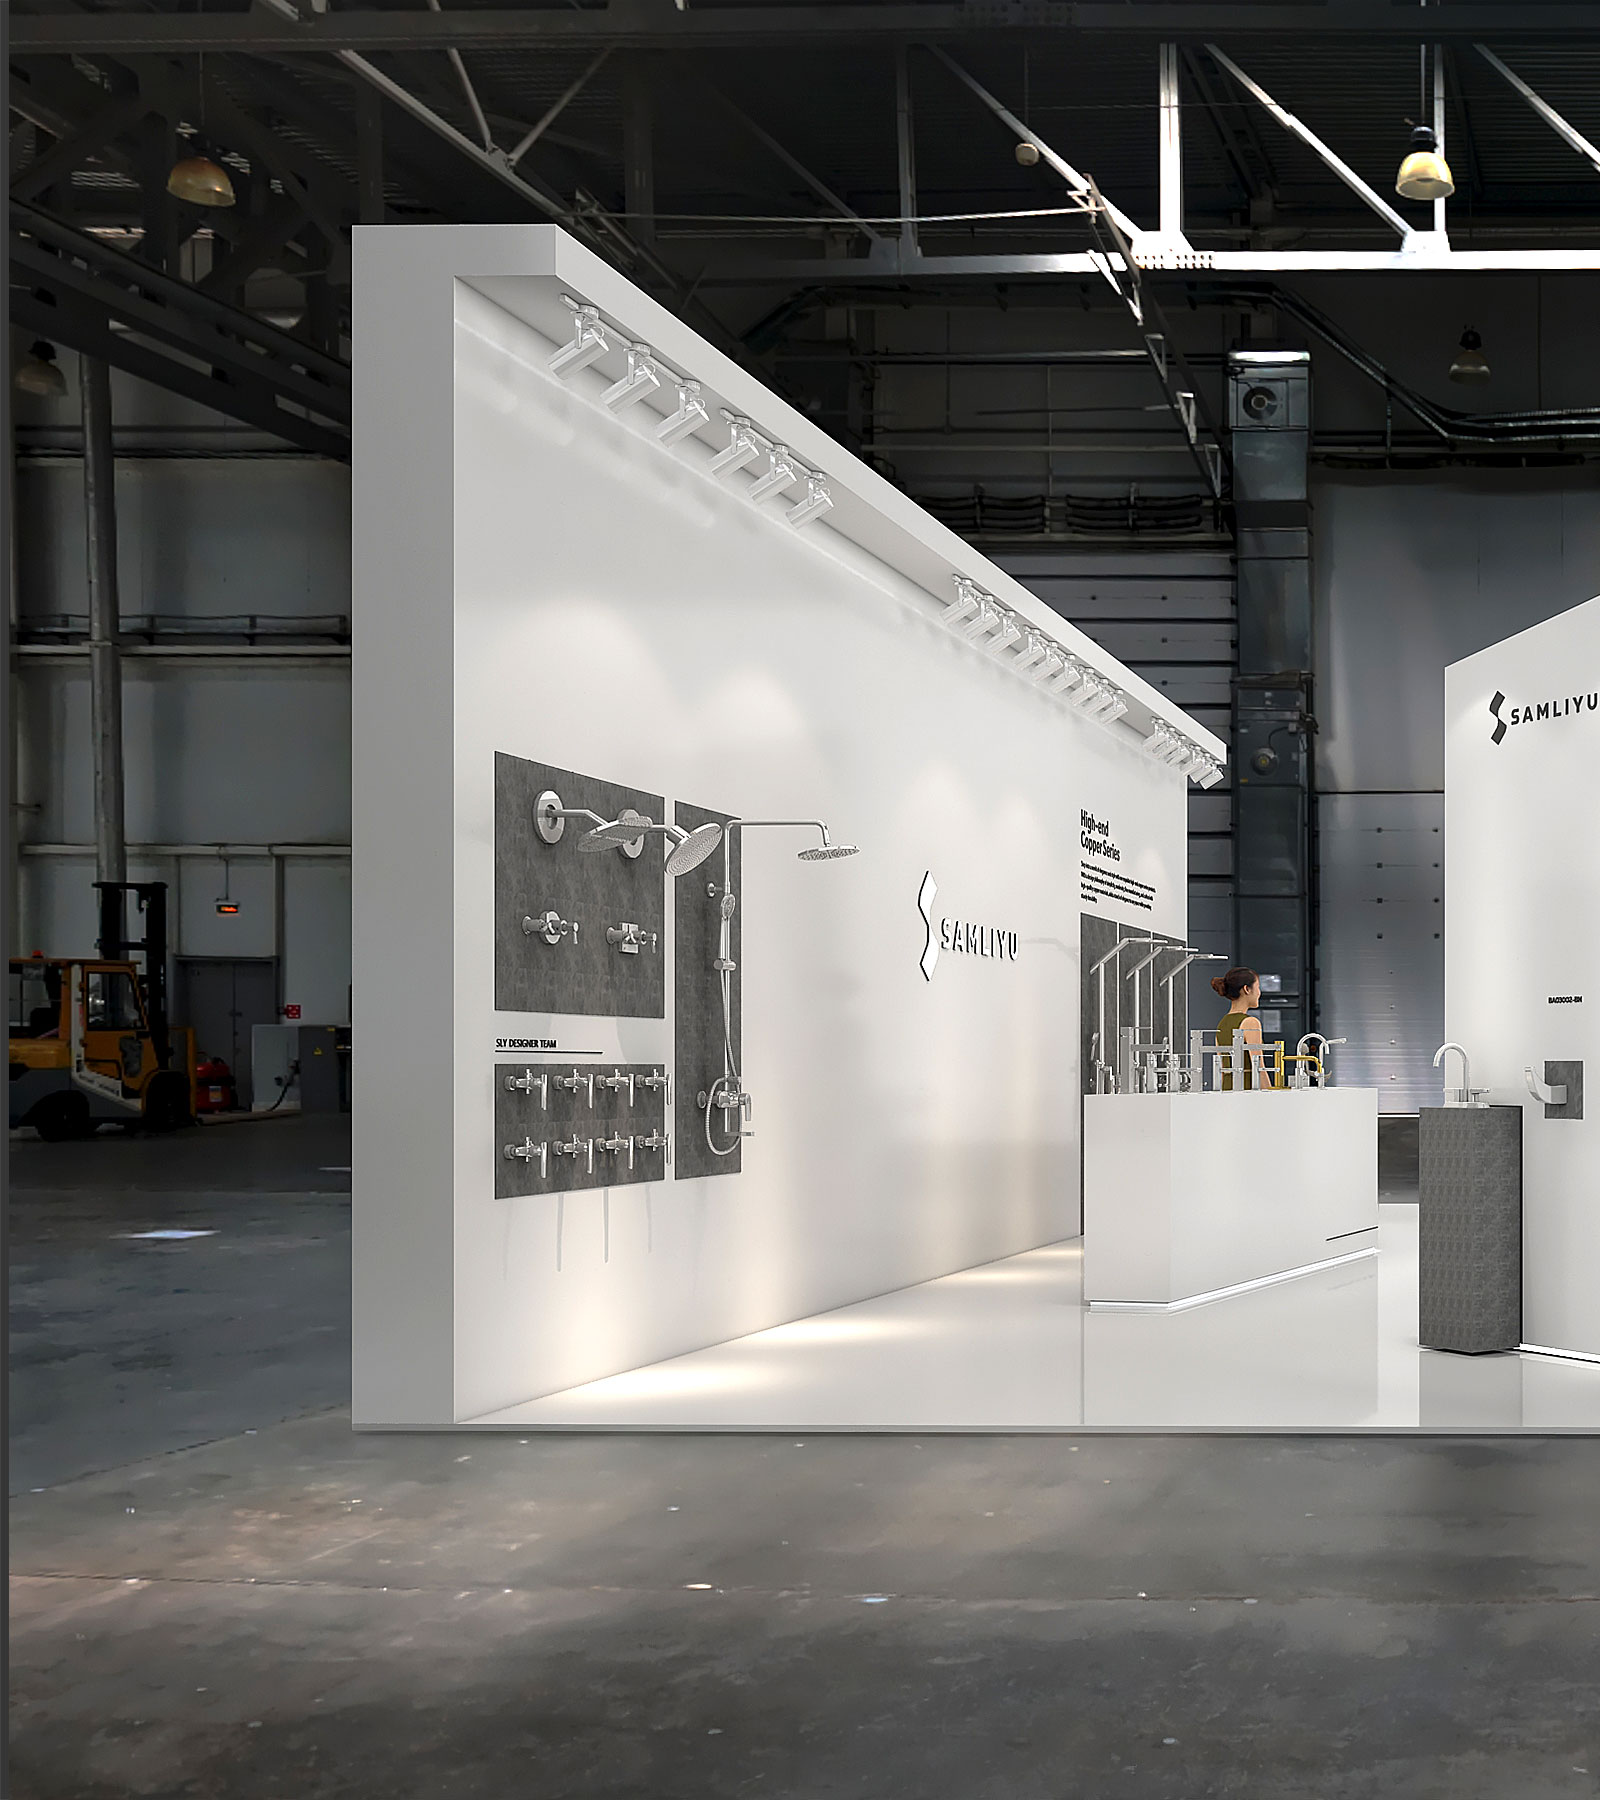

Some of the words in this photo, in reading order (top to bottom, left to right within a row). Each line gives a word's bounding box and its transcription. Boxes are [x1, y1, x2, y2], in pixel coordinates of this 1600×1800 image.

[1511, 692, 1598, 726] SAMLIYU
[1080, 808, 1109, 837] High-end
[1080, 830, 1103, 857] Copper
[1102, 839, 1121, 862] Series
[940, 916, 1019, 962] SAMLIYU
[495, 1038, 508, 1048] SLY
[508, 1039, 539, 1049] DESIGNER
[539, 1039, 557, 1049] TEAM
